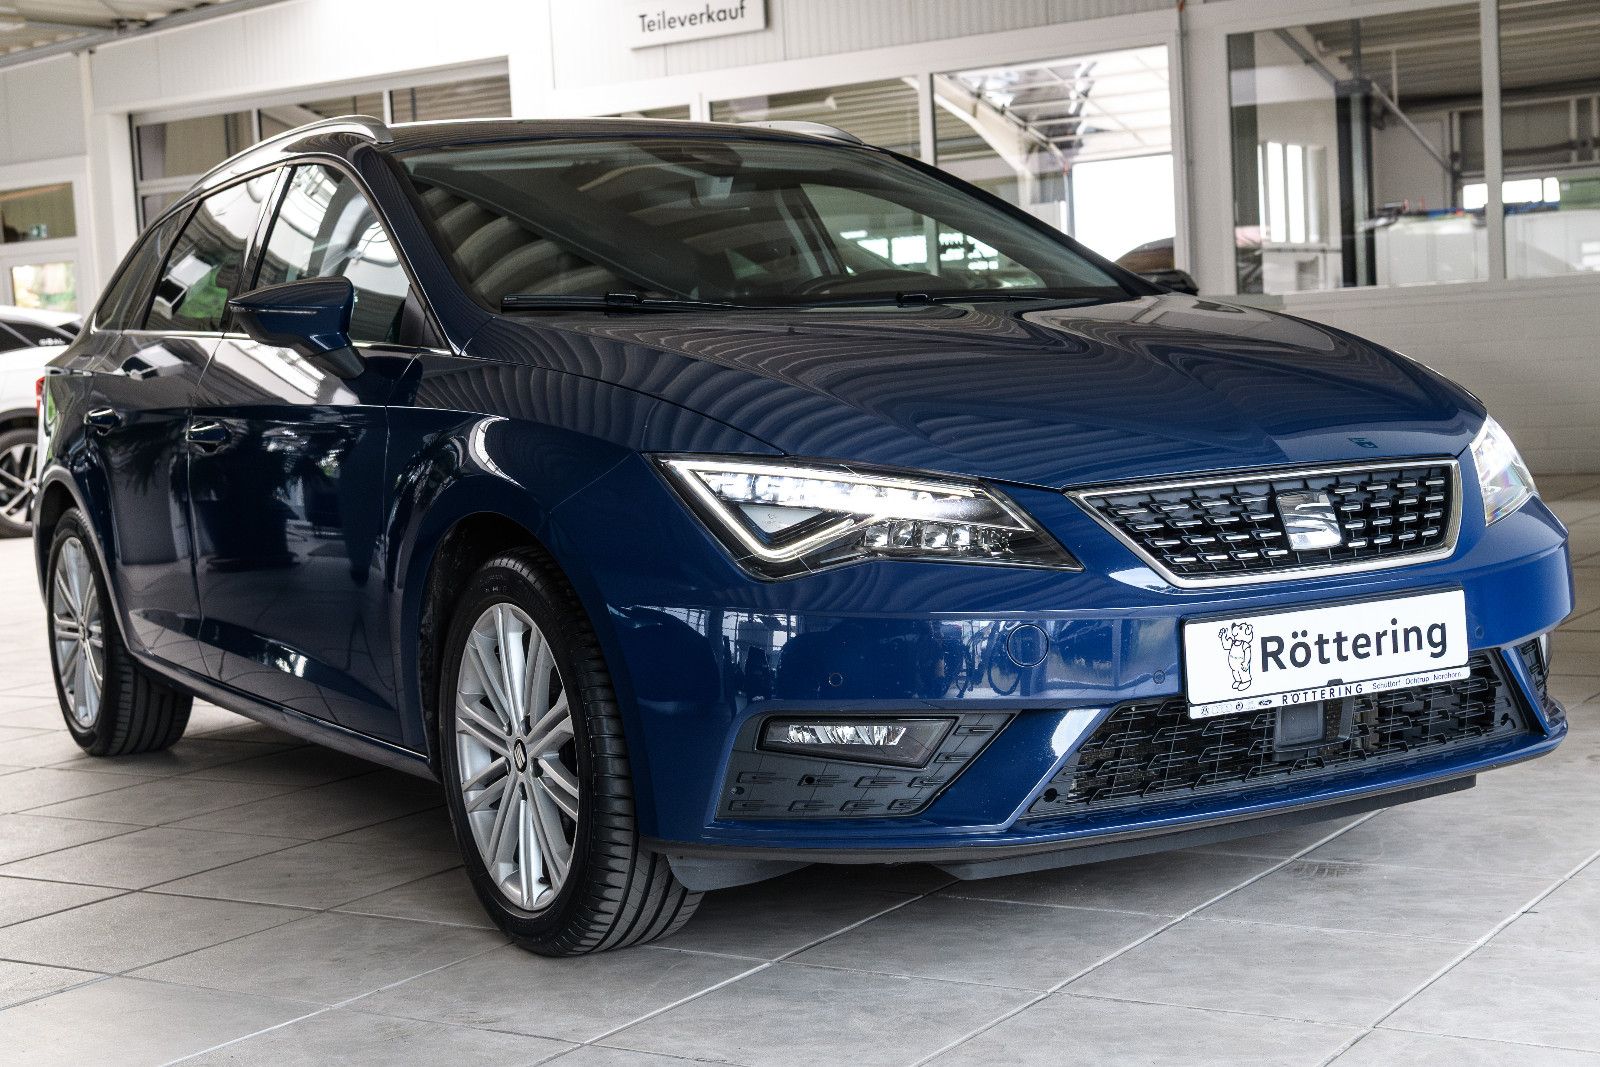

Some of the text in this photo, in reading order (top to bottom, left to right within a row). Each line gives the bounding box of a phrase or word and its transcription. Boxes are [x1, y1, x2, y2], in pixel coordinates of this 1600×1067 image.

[638, 0, 746, 32] Teileverkauf
[1260, 618, 1447, 673] Röttering
[1282, 684, 1363, 705] RÖTTERING
